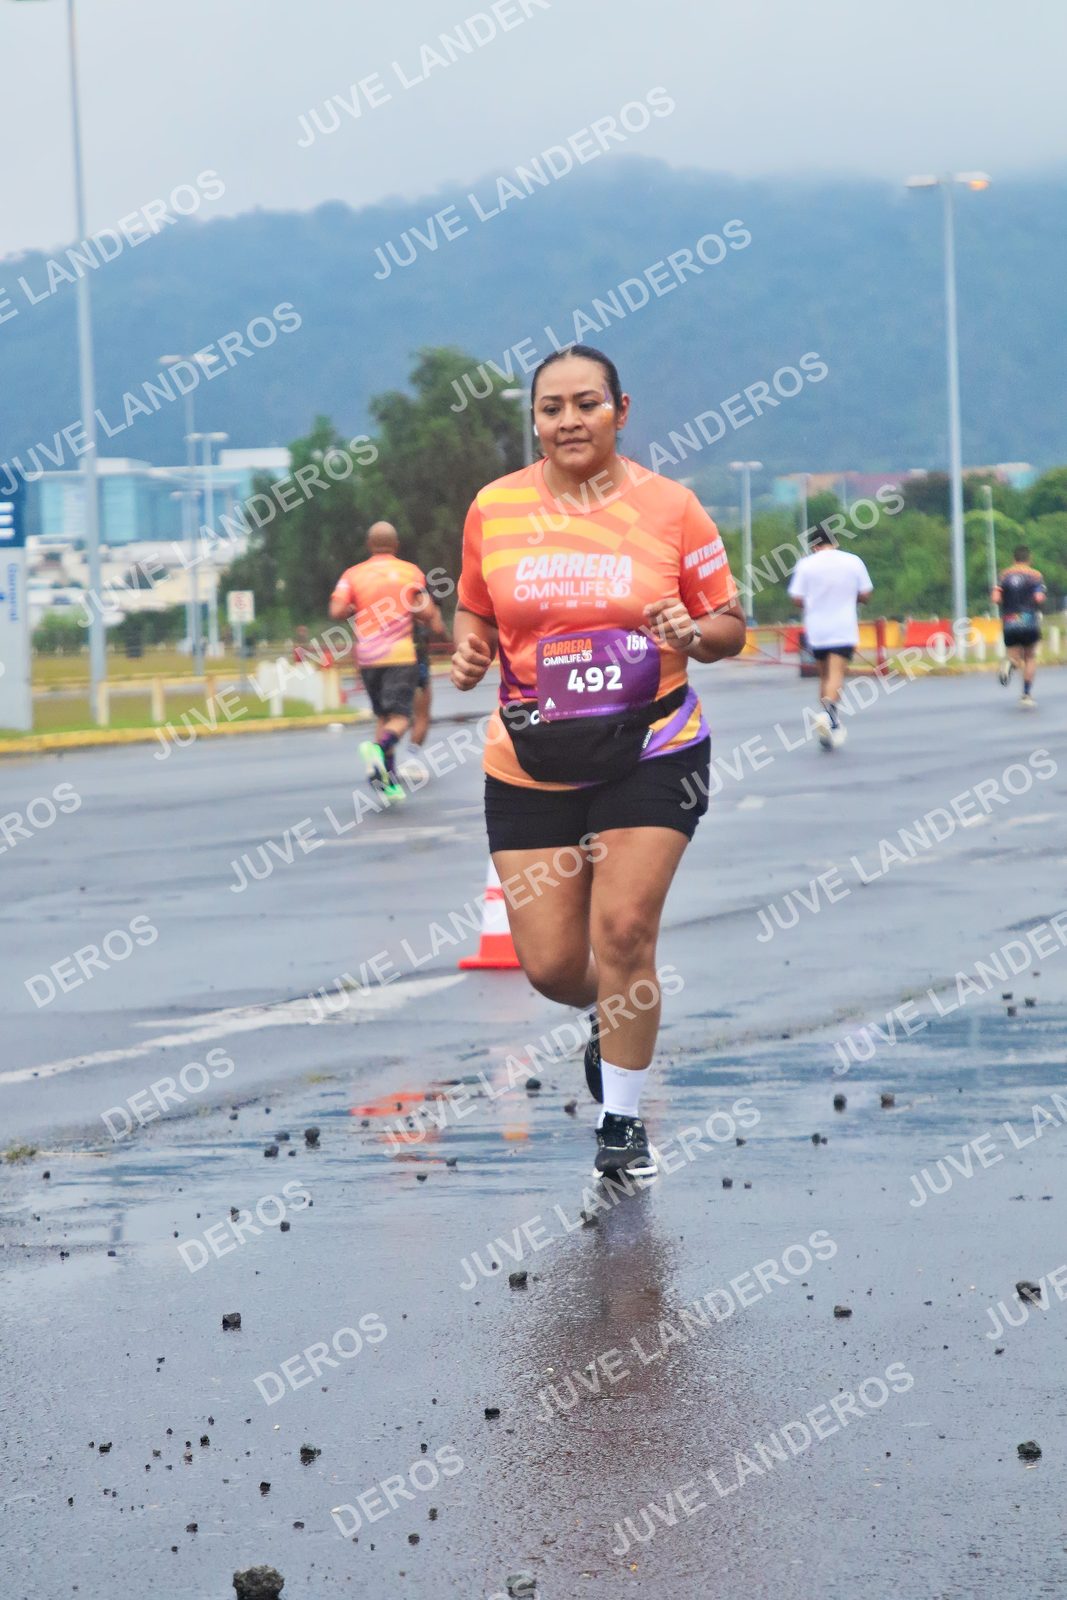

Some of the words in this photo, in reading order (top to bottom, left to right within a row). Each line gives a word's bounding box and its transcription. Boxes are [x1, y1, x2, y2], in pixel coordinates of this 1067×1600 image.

[516, 553, 632, 580] CARRERA
[543, 638, 592, 656] CARRERA
[626, 634, 648, 651] 15K
[567, 665, 623, 693] 492
